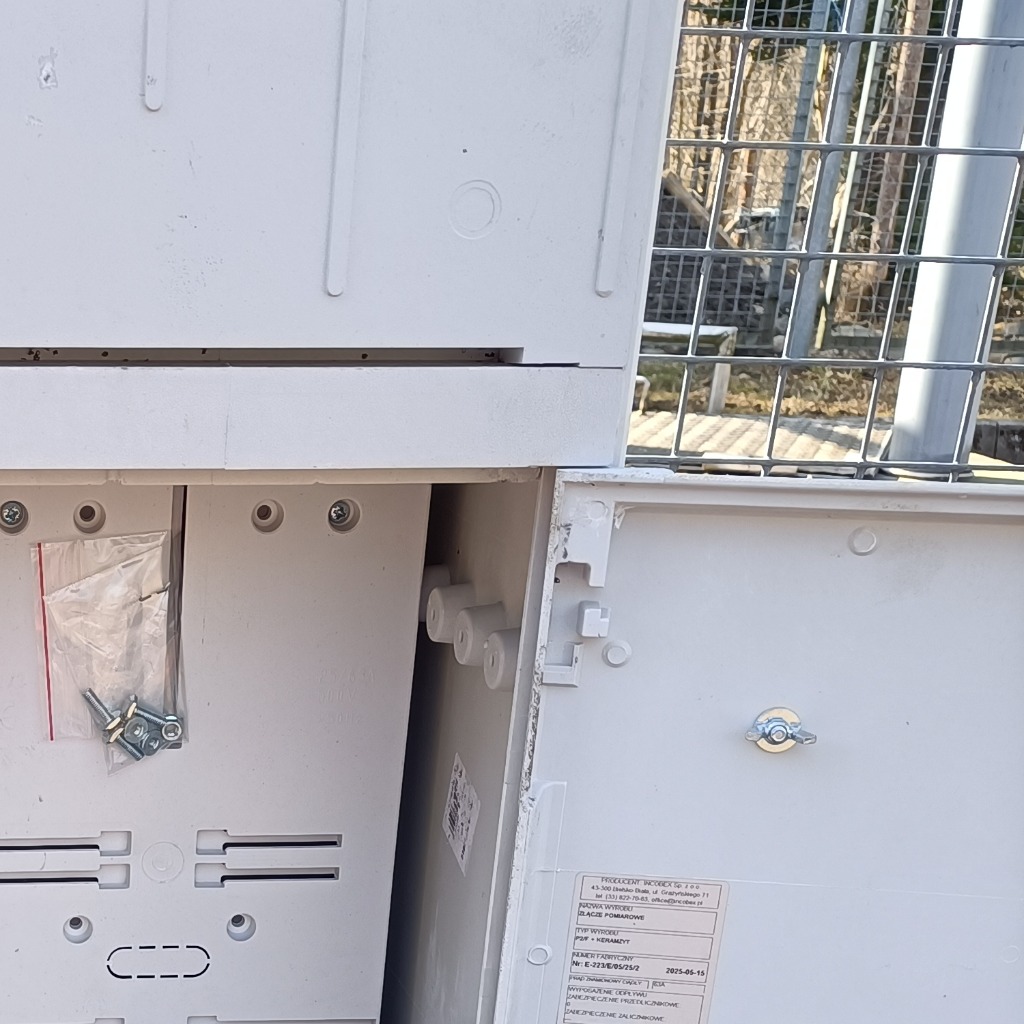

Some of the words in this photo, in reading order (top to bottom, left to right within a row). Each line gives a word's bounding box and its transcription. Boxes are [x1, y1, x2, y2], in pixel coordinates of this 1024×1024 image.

[604, 912, 645, 921] POMIAROWE
[596, 937, 630, 945] KERAMZYT
[665, 967, 705, 977] 2025-05-15
